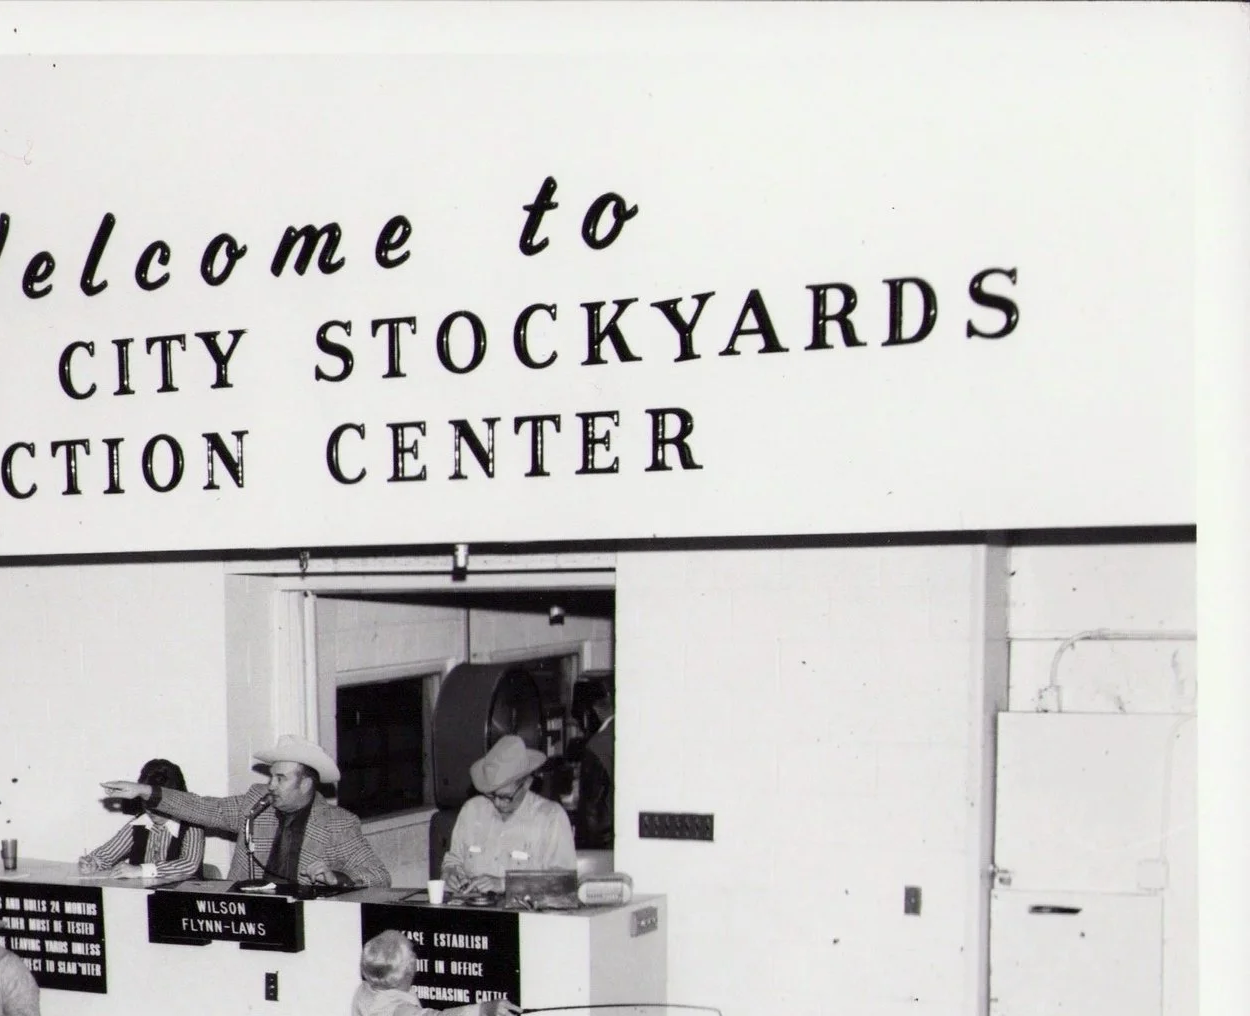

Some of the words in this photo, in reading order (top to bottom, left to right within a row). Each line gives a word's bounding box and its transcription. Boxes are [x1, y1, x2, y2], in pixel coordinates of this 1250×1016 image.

[518, 175, 640, 257] to
[57, 329, 249, 400] CITY
[313, 267, 1020, 383] STOCKYARDS
[325, 407, 704, 485] CENTER
[5, 897, 21, 911] AND
[50, 900, 61, 913] 24
[64, 901, 98, 916] MONTHS
[196, 900, 247, 916] WILSON
[28, 918, 50, 932] MUST
[53, 920, 63, 935] BE
[67, 921, 95, 937] TESTED
[181, 917, 267, 937] FLYNN-LAWS
[10, 936, 41, 953] LEAVING
[44, 939, 69, 955] YARDS
[71, 942, 102, 957] UNLESS
[432, 932, 489, 951] ESTABLISH
[45, 959, 56, 974] TO
[434, 960, 446, 974] IN
[450, 961, 484, 978] OFFICE
[413, 985, 471, 1004] PURCHASING
